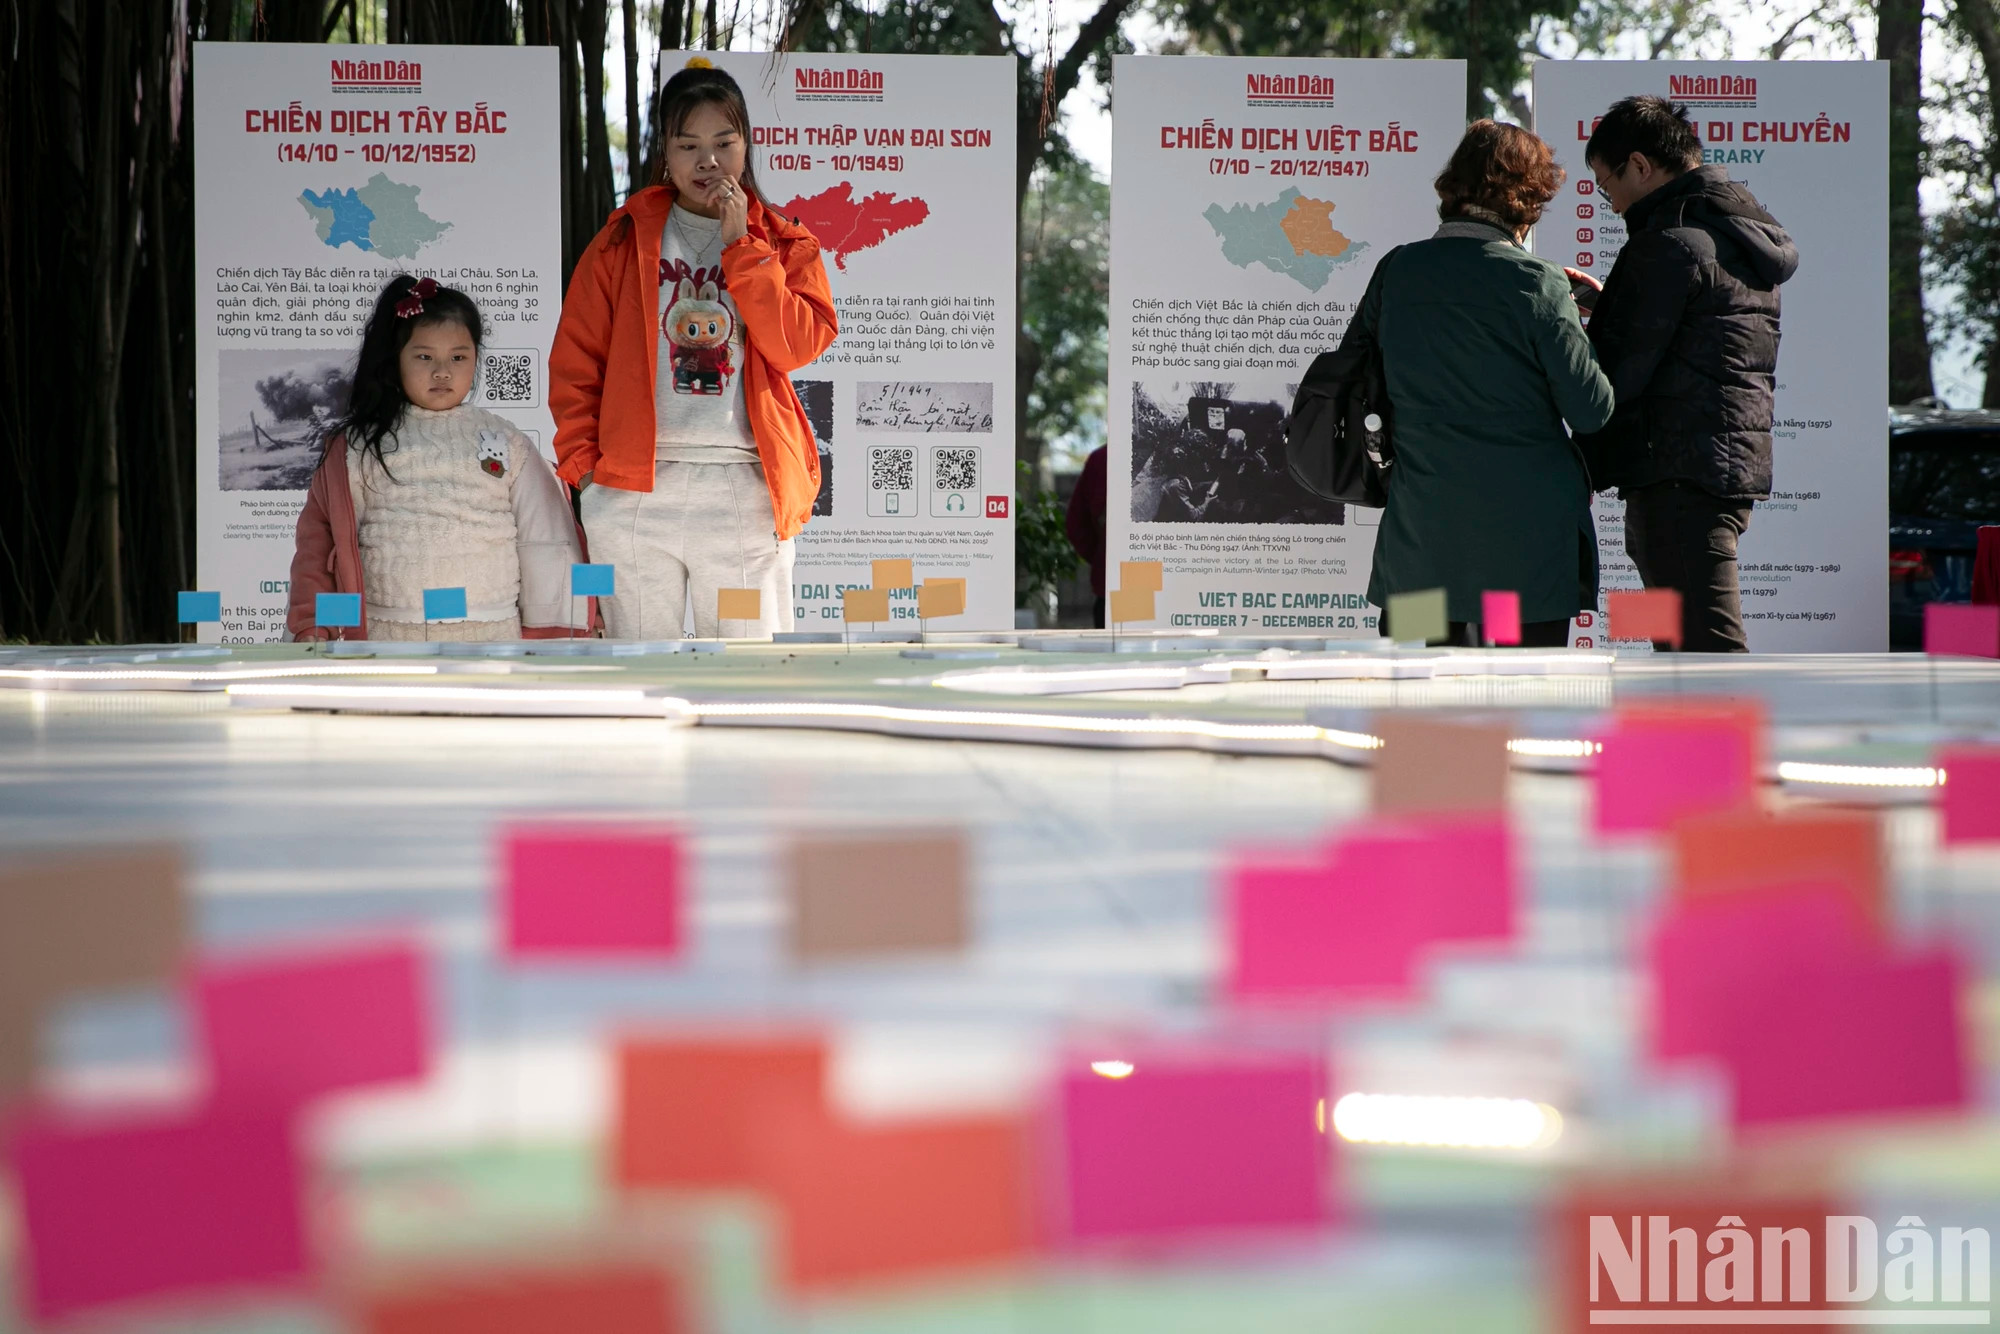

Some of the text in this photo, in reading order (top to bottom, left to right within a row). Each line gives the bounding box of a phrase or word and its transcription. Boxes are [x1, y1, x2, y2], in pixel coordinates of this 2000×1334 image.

[332, 60, 421, 80] Nhân Dân
[796, 68, 883, 88] Nhân Dân
[1248, 74, 1334, 94] Nhân Dân
[1670, 75, 1756, 95] Nhân Dân
[246, 102, 506, 136] CHIẾN DỊCH TÂY BẮC
[1708, 122, 1733, 142] DI
[1743, 113, 1850, 142] CHUYỂN
[752, 124, 990, 149] DỊCH THẬP VẠN ĐẠI SƠN
[1162, 119, 1418, 154] CHIẾN DỊCH VIỆT BẮC
[278, 143, 475, 163] (14/10 10/12/1952)
[770, 154, 903, 172] (10/6 10/1949)
[1210, 158, 1368, 177] (7/10 20/12/1947)
[1579, 183, 1591, 192] 01
[1578, 207, 1591, 216] 02
[1578, 231, 1591, 240] 03
[1578, 255, 1591, 264] 04
[216, 267, 250, 278] Chiến
[254, 268, 278, 279] dịch
[282, 268, 301, 280] Tây
[305, 267, 326, 278] Bắc
[330, 267, 355, 278] diễn
[359, 270, 370, 278] ra
[374, 268, 387, 280] tại
[441, 268, 456, 278] Lai
[217, 282, 238, 292] Lào
[242, 282, 262, 292] Cai,
[265, 282, 286, 292] Yên
[290, 282, 310, 292] Bái,
[314, 283, 325, 292] ta
[329, 282, 349, 294] loại
[471, 283, 492, 292] hơn
[496, 283, 503, 292] 6
[507, 282, 538, 295] nghìn
[845, 295, 869, 305] diễn
[886, 296, 899, 307] tại
[903, 296, 928, 306] ranh
[931, 296, 950, 308] giới
[954, 297, 970, 306] hai
[974, 296, 994, 306] tỉnh
[1133, 298, 1345, 312] Chiến dịch Việt Bắc là chiến dịch đầu
[1132, 313, 1162, 323] chiến
[1166, 314, 1200, 326] chống
[1205, 314, 1229, 326] thực
[1233, 315, 1254, 324] dân
[1258, 315, 1286, 326] Pháp
[1289, 315, 1309, 326] của
[1313, 316, 1342, 326] Quân
[843, 339, 994, 351] mang lại thắng lợi to lớn về
[1132, 356, 1299, 369] Pháp bước sang giai đoạn mới.
[988, 501, 1006, 513] 04
[801, 584, 829, 599] DAI
[1199, 592, 1368, 609] VIET BAC CAMPAIGN
[222, 606, 256, 617] In this
[221, 621, 265, 631] Yen Bai
[1171, 614, 1358, 629] (OCTOBER 7 DECEMBER 20,
[1578, 615, 1589, 625] 19
